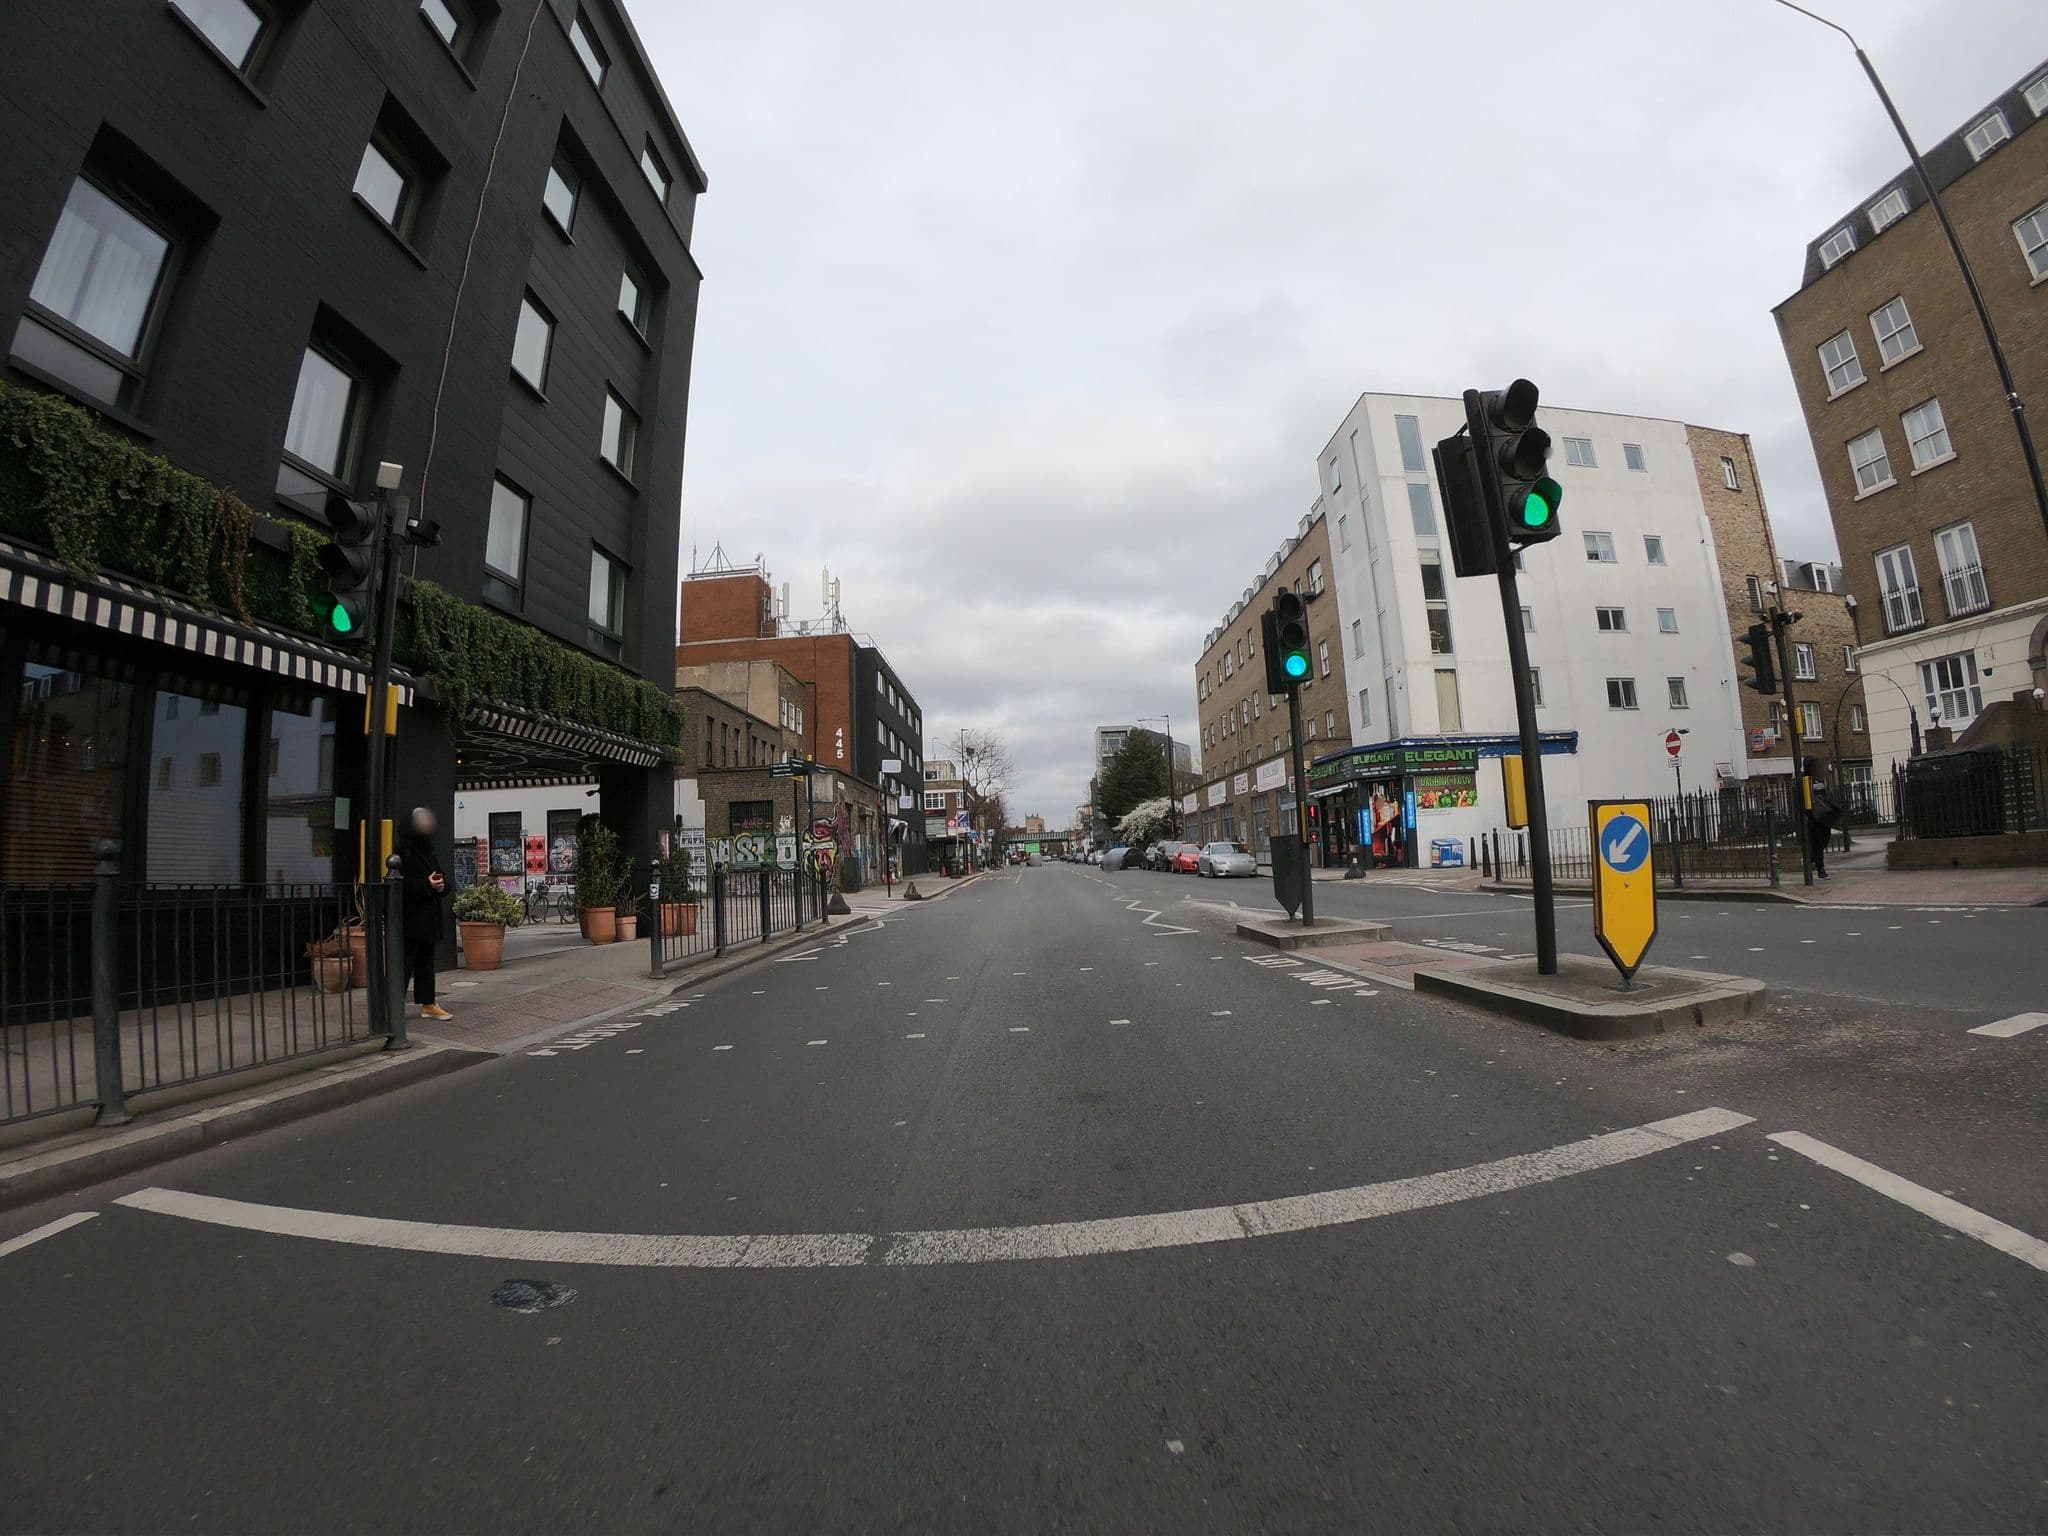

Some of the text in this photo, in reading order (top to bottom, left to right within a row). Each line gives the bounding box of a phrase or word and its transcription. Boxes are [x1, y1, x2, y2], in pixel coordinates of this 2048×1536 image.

[836, 727, 844, 759] 445
[1352, 752, 1396, 765] ELEGANT
[1404, 749, 1475, 762] ELEGANT
[1453, 775, 1472, 785] FOOD
[1242, 954, 1370, 991] LOOK LEFT
[541, 1022, 643, 1050] RIGHT
